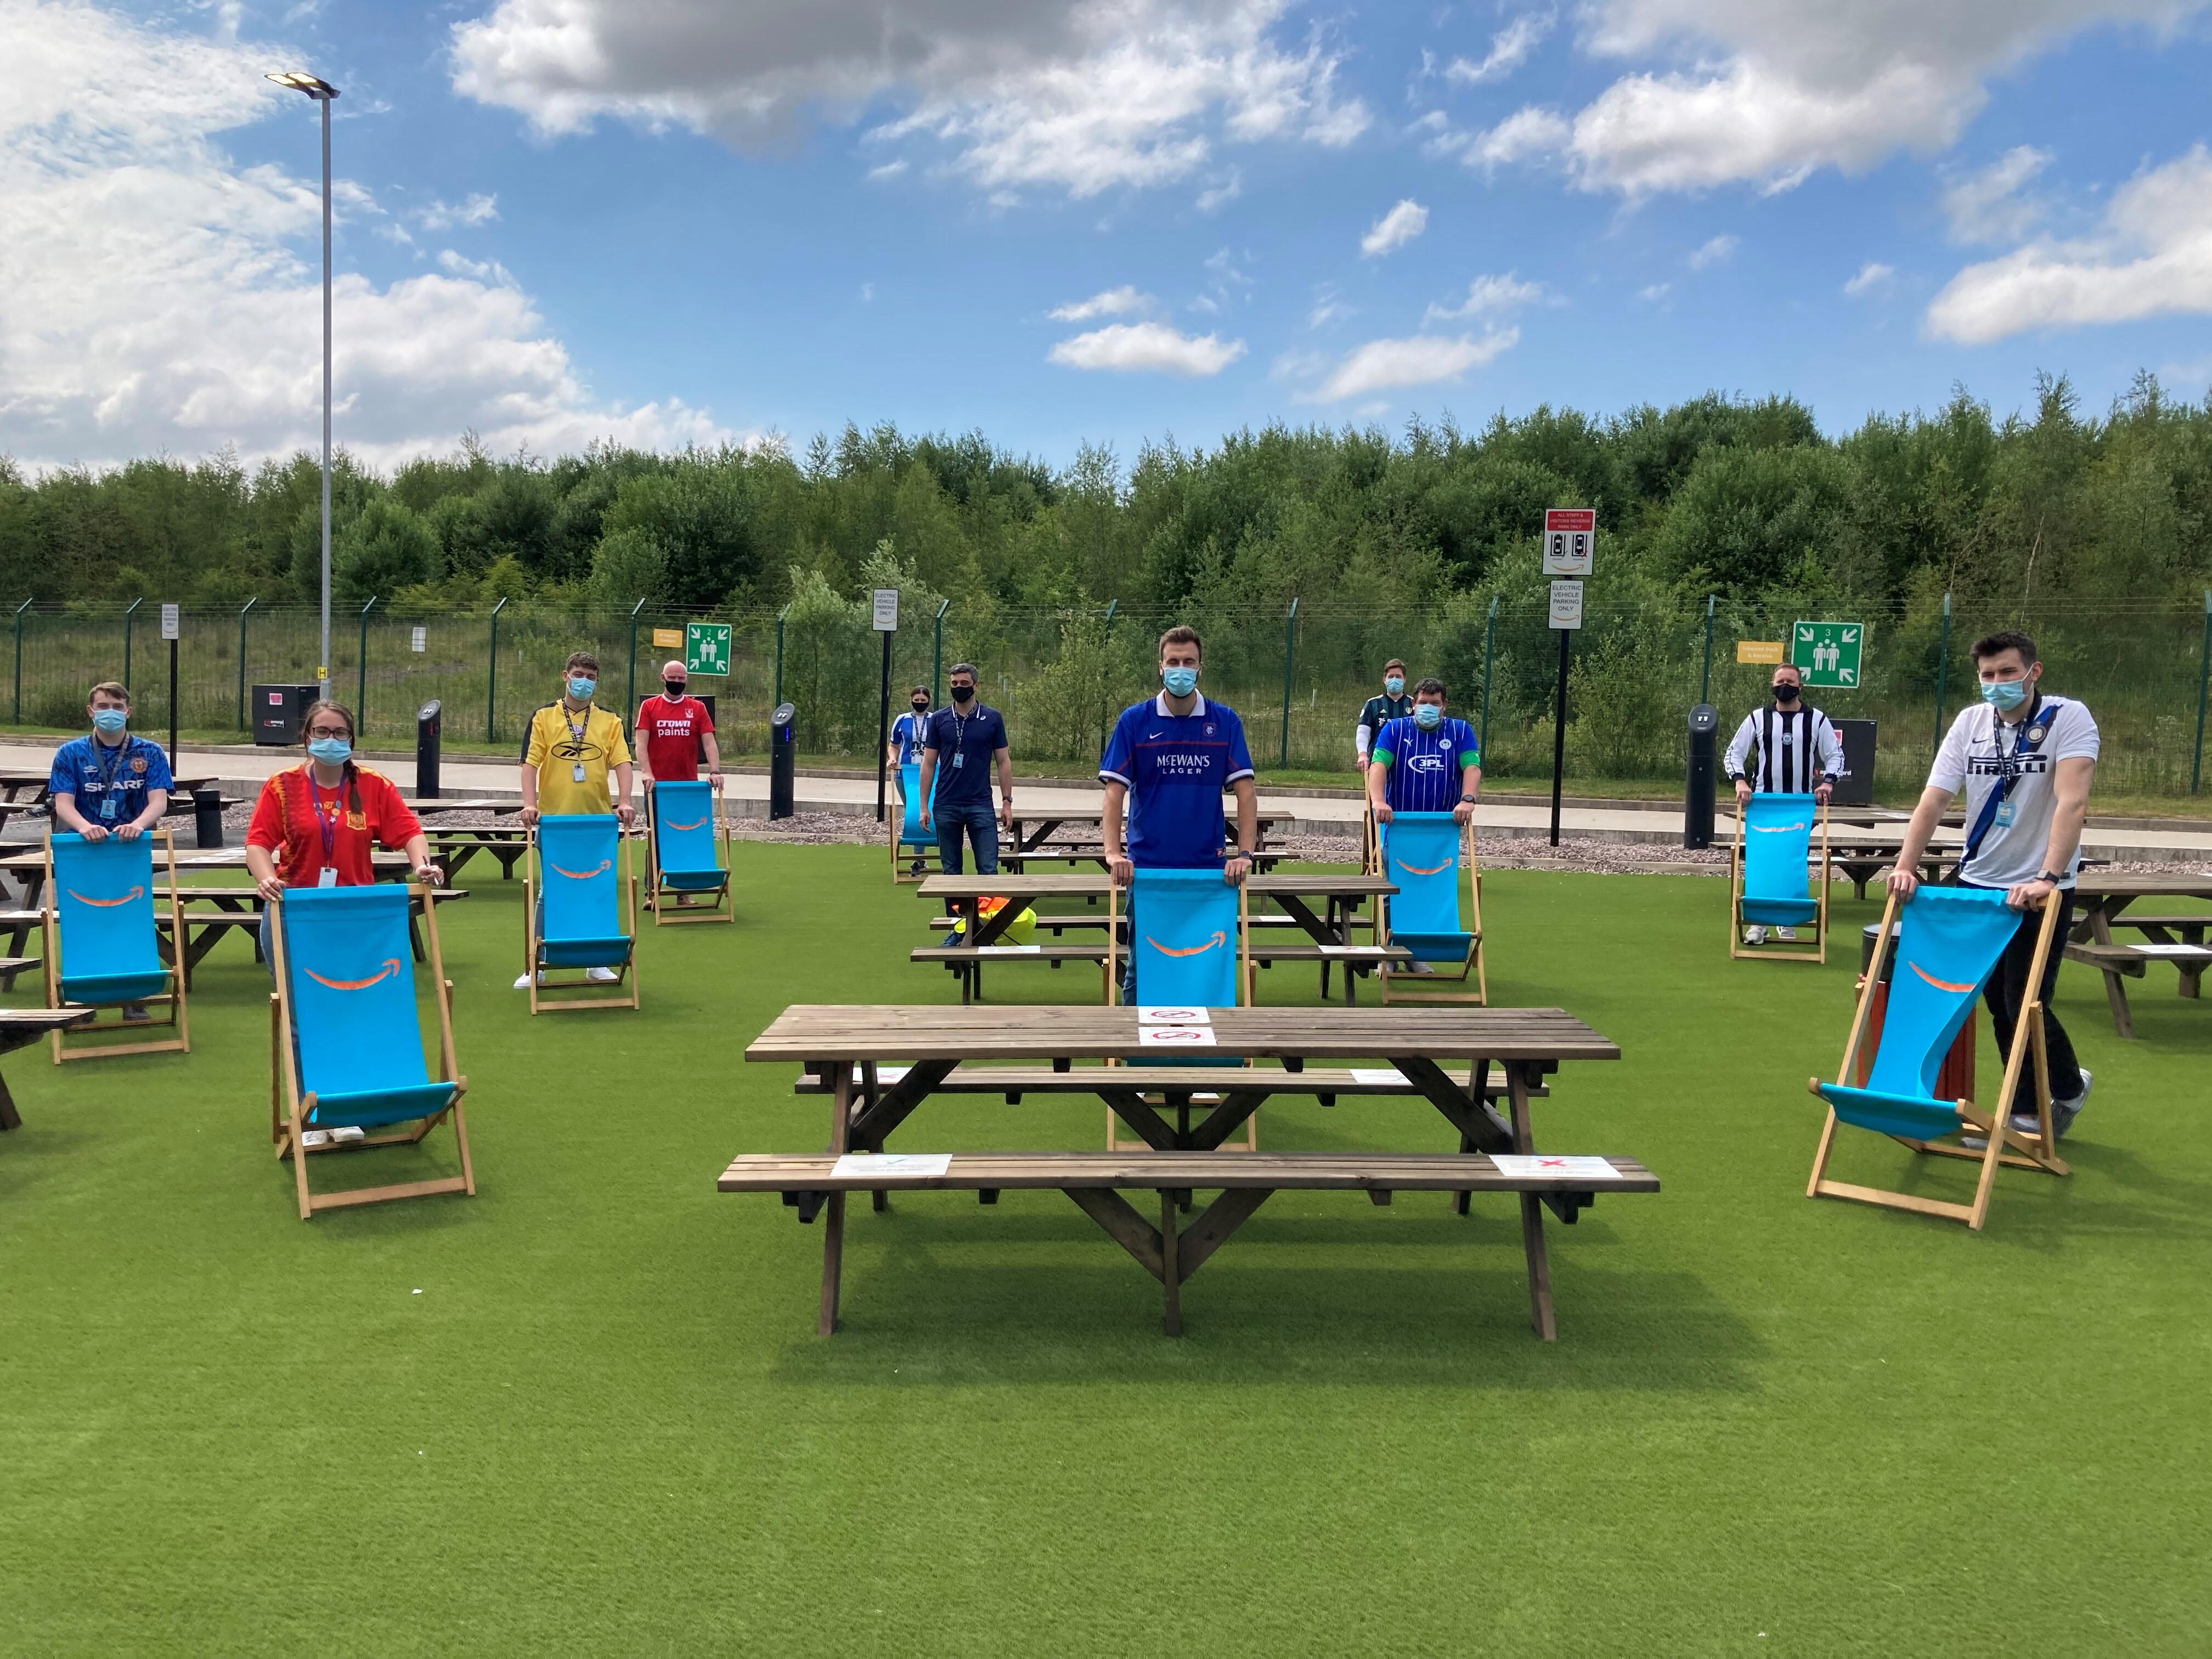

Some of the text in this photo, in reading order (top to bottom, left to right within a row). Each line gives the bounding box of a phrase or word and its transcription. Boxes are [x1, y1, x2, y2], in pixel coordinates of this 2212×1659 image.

[319, 668, 326, 678] H
[658, 727, 690, 738] paints
[1419, 759, 1444, 768] 3PL
